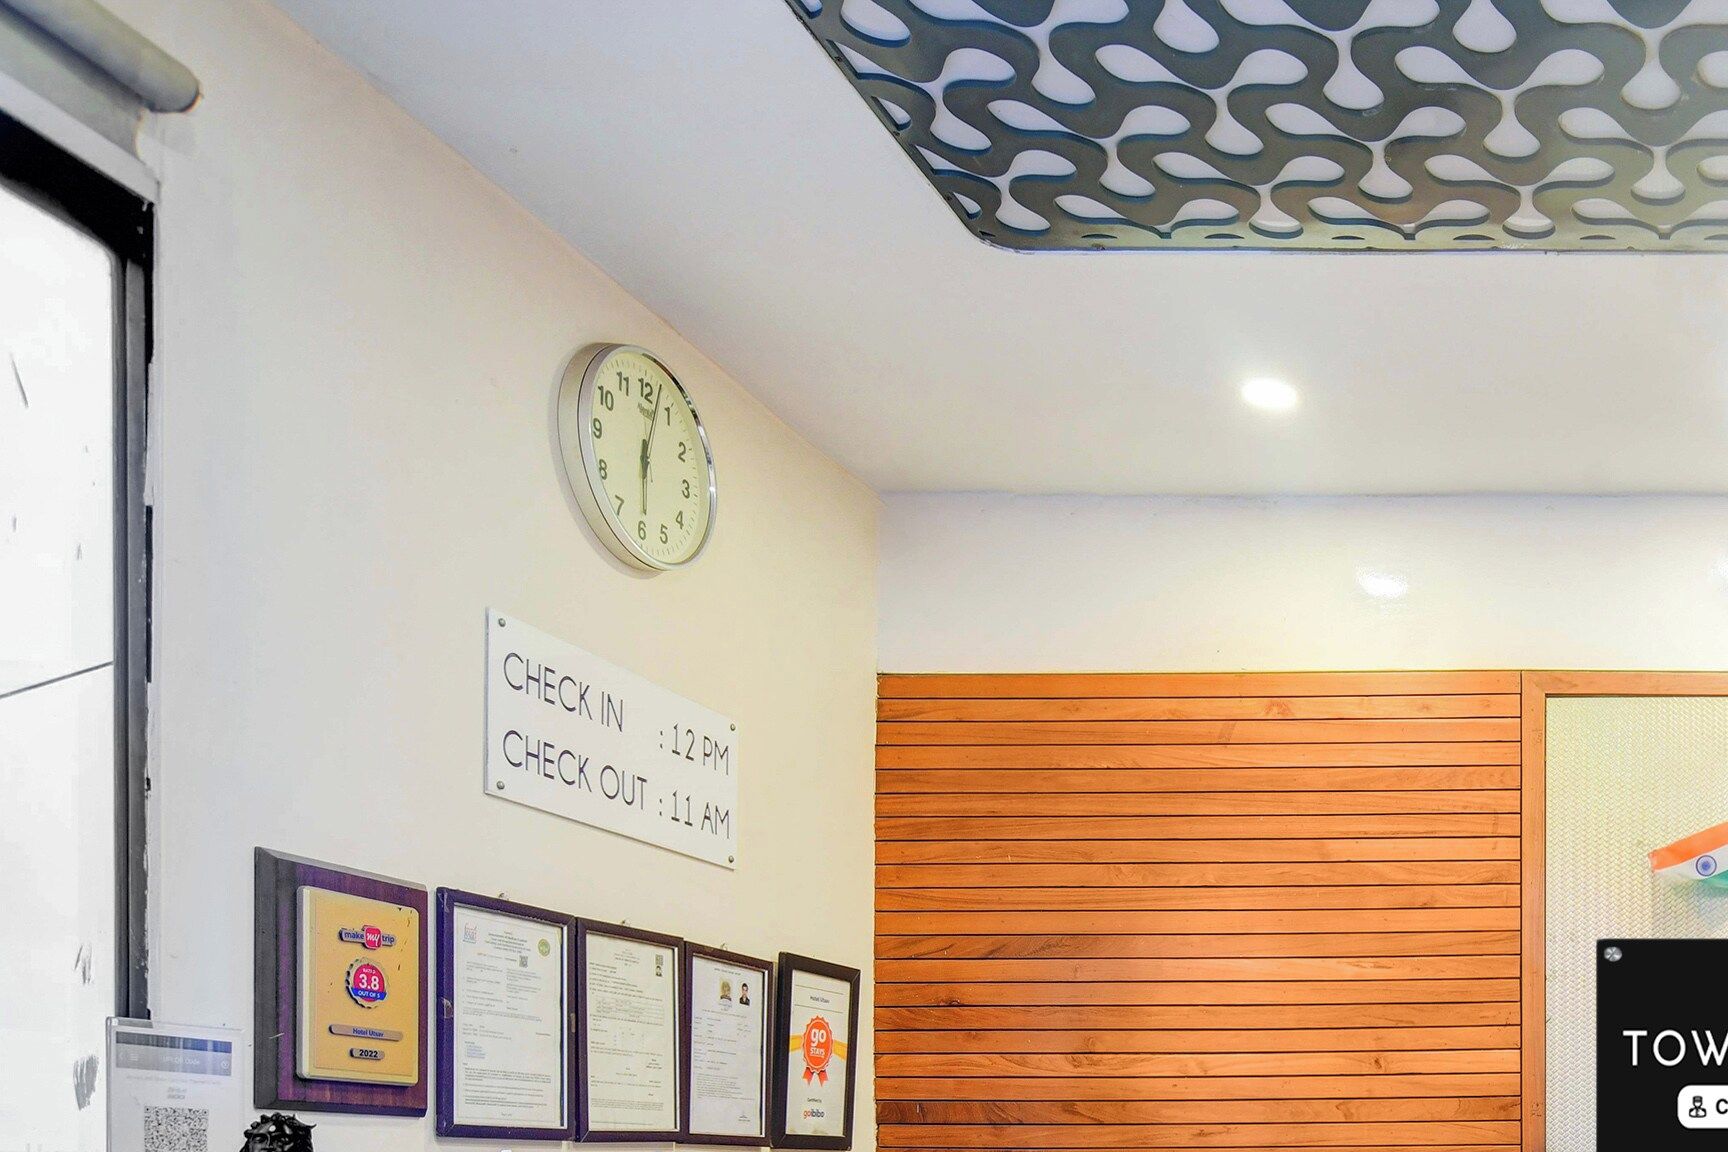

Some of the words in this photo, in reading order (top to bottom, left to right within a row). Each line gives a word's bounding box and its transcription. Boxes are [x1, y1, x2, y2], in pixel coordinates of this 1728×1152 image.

[616, 371, 630, 396] 11
[637, 377, 654, 404] 12
[597, 385, 614, 411] 10
[664, 406, 672, 426] 1
[592, 418, 603, 439] 9
[677, 441, 687, 462] 2
[598, 459, 608, 480] 8
[681, 479, 691, 499] 3
[614, 495, 625, 516] 7
[637, 520, 647, 541] 6
[674, 510, 684, 530] 4
[659, 523, 668, 545] 5
[503, 652, 593, 720] CHECK
[600, 691, 624, 732] IN
[703, 735, 729, 775] PM
[502, 729, 592, 793] CHECK
[599, 764, 648, 811] OUT
[701, 801, 730, 839] AM
[359, 974, 380, 990] 3.8
[810, 1028, 827, 1047] go
[359, 1049, 378, 1058] 2022
